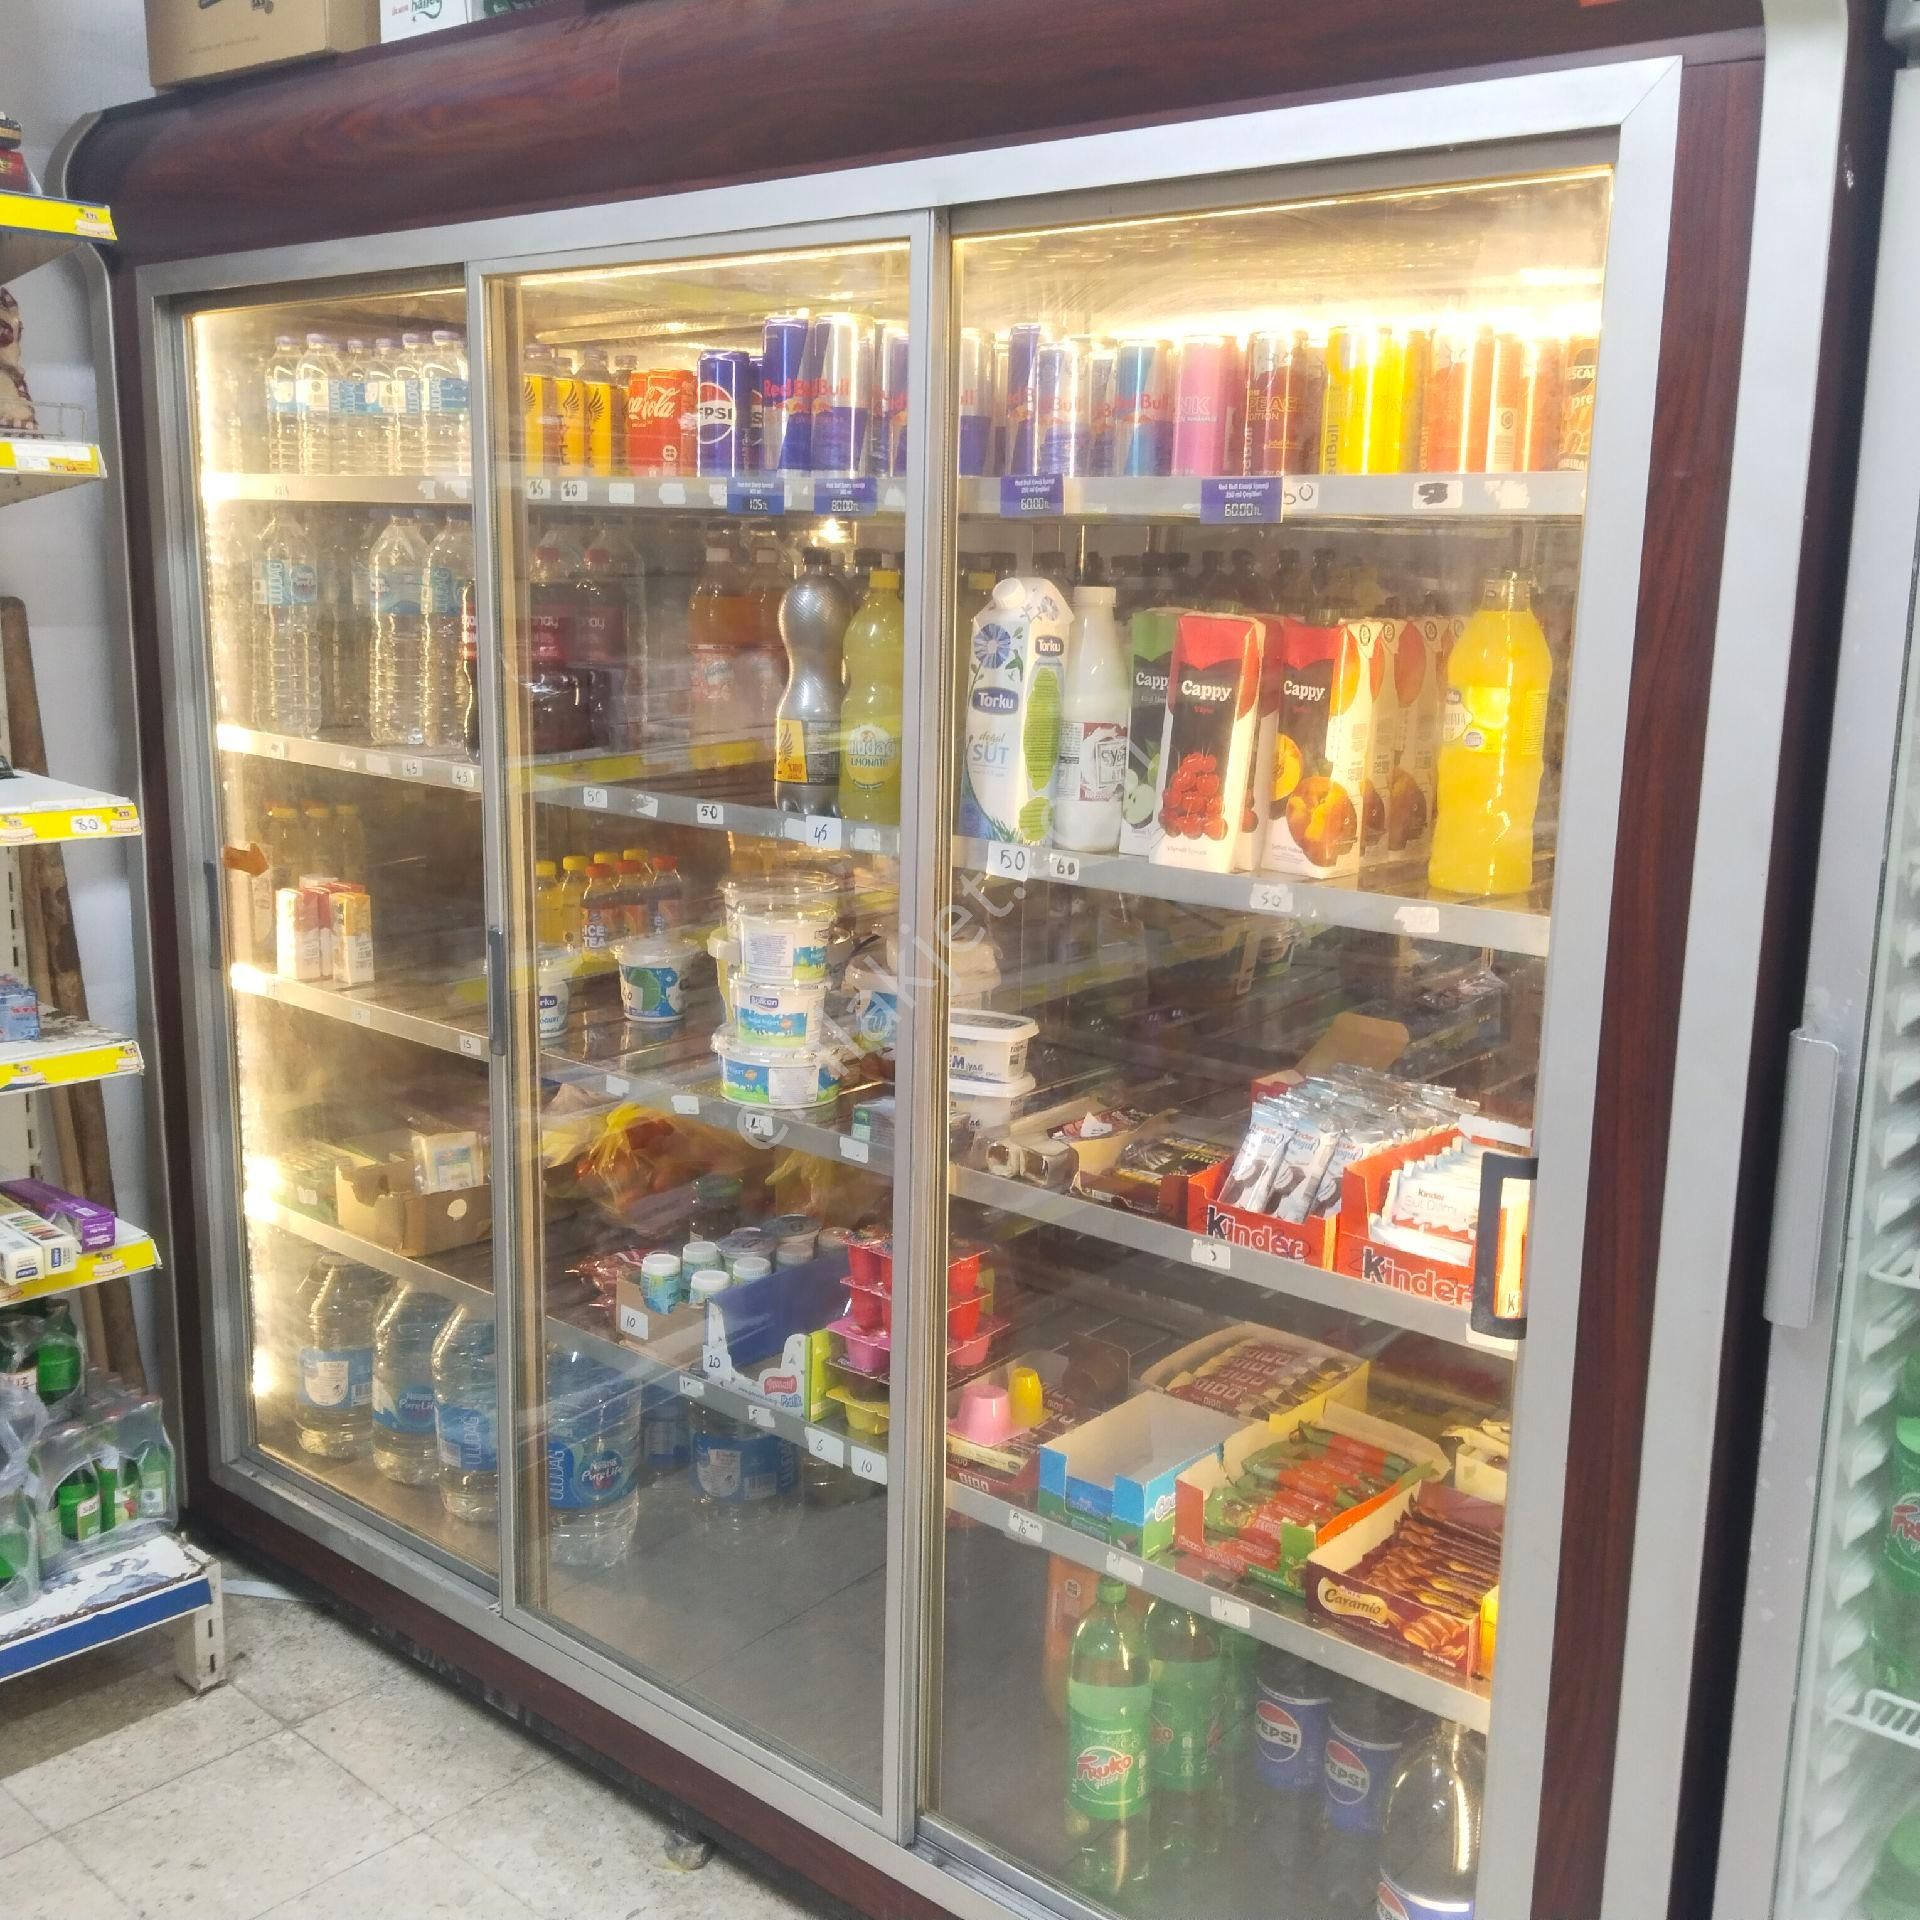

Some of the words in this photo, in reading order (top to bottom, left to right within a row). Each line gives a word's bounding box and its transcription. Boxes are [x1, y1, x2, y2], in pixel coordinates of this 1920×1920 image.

[697, 406, 734, 421] EPSI
[1038, 639, 1061, 652] Torku
[1135, 671, 1169, 690] Capp
[1181, 679, 1233, 702] Cappy
[1283, 679, 1326, 702] Cappy
[978, 692, 1014, 710] Torku
[701, 804, 719, 819] 50
[75, 818, 98, 831] 80
[1000, 850, 1026, 871] 50
[1260, 891, 1282, 908] 50
[583, 924, 605, 937] ICE
[583, 936, 605, 948] TEA
[626, 1317, 636, 1328] 10
[421, 1400, 434, 1411] Lif
[860, 1460, 873, 1474] 10
[1324, 1588, 1382, 1616] Caramio
[1077, 1753, 1134, 1781] Fruko
